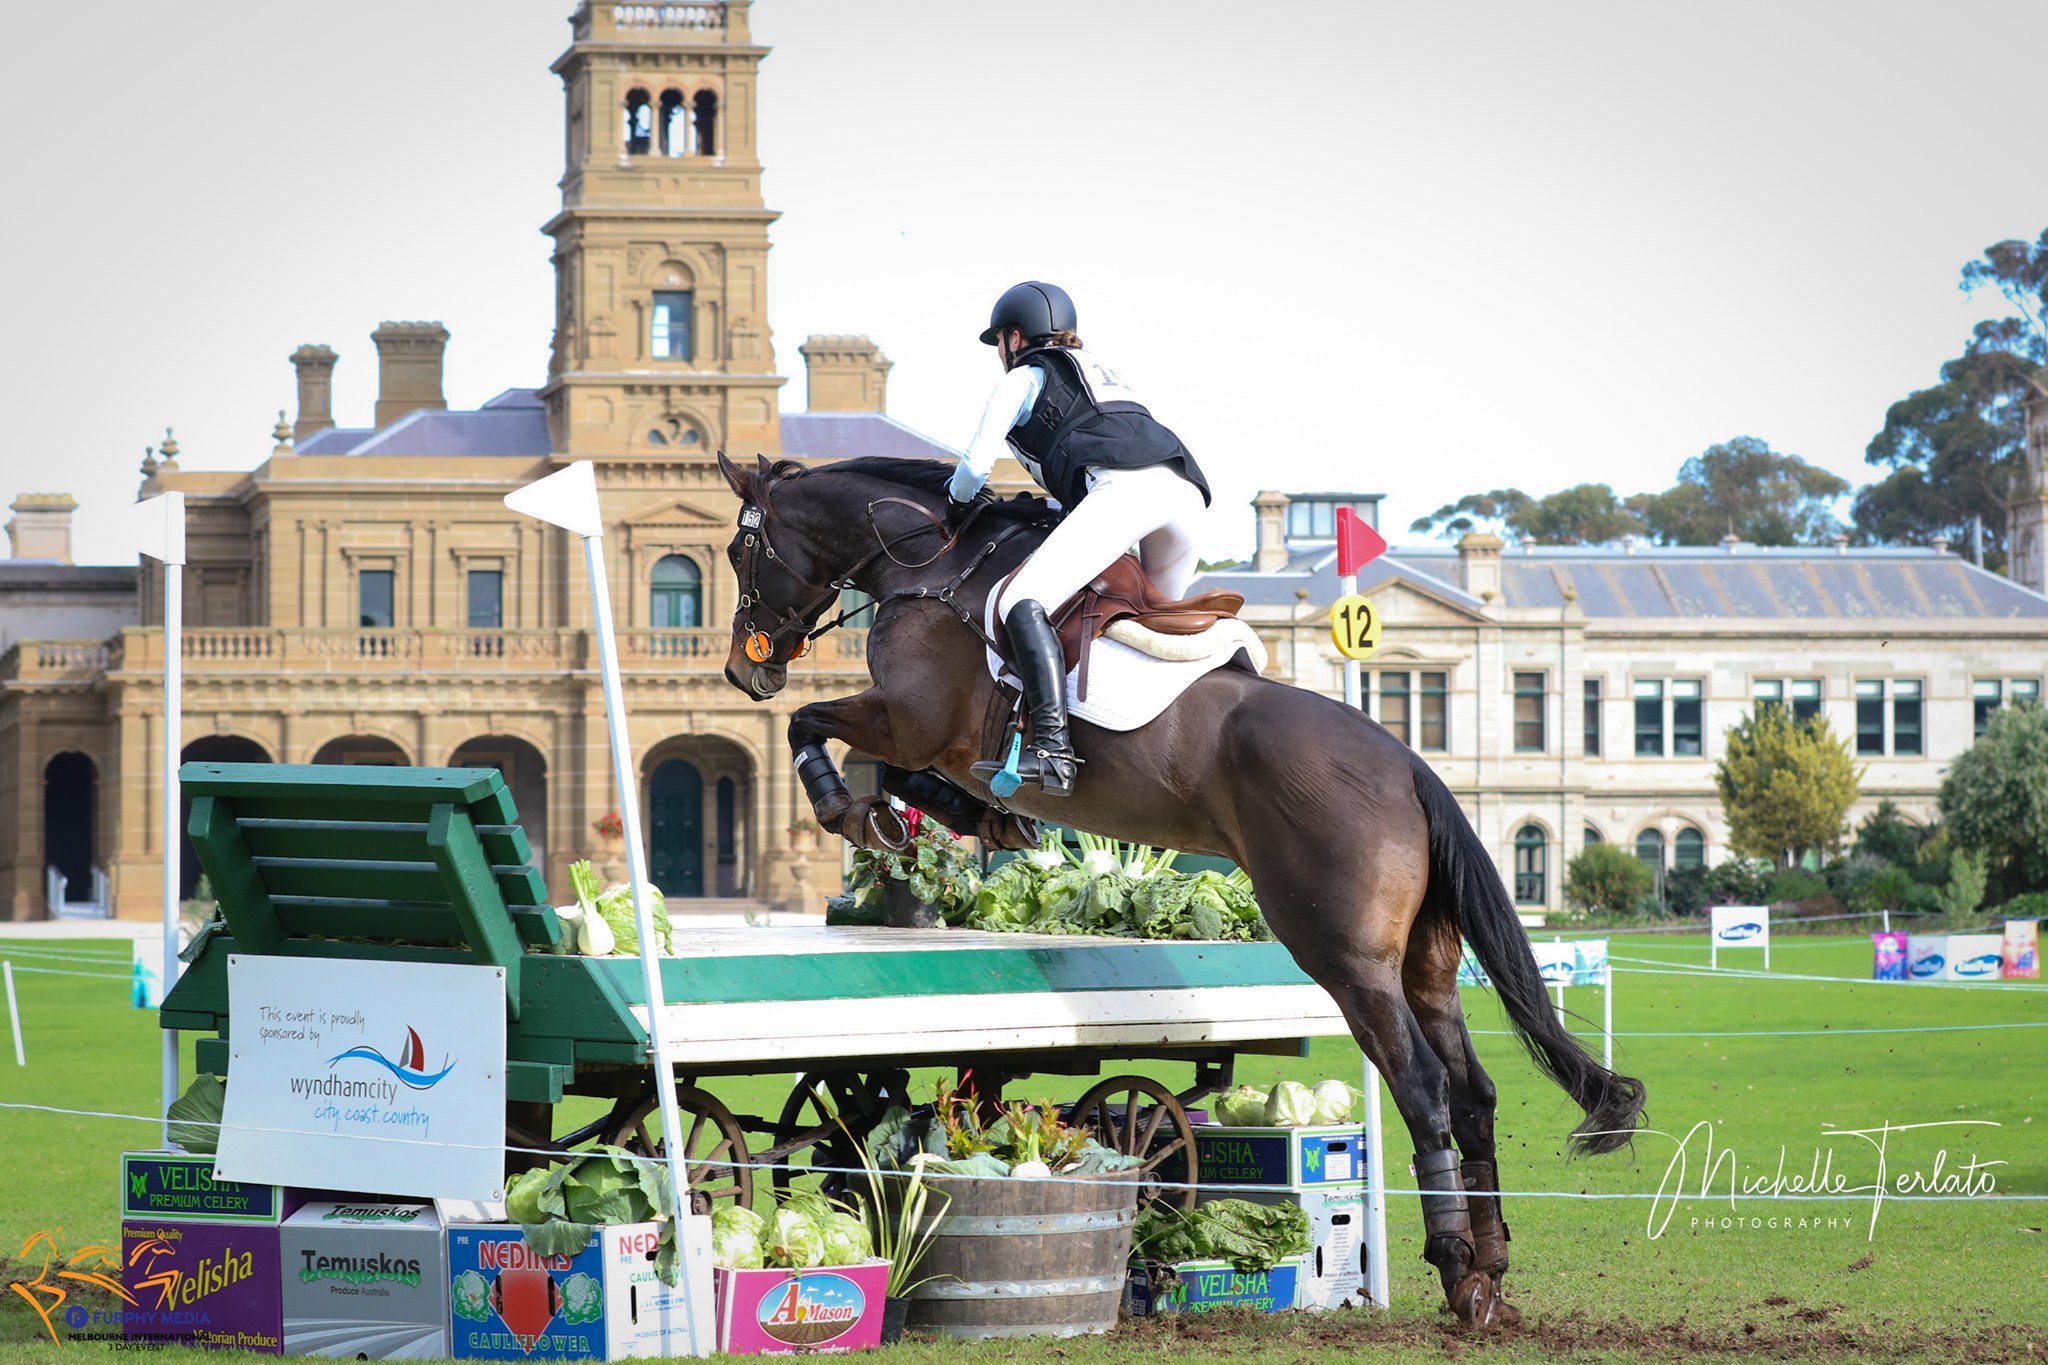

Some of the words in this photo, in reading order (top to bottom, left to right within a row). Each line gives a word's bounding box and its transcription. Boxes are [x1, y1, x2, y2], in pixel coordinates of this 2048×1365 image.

[1340, 604, 1373, 649] 12
[259, 1006, 282, 1022] This
[285, 1009, 314, 1023] event
[319, 1010, 327, 1024] is
[331, 1011, 365, 1033] proudly
[259, 1027, 305, 1046] sponsored
[309, 1028, 321, 1049] by
[1220, 1167, 1264, 1180] CELERY
[149, 1193, 200, 1208] PREMIUM
[204, 1195, 249, 1210] CELERY
[331, 1205, 421, 1218] Temuskos
[123, 1227, 155, 1239] Premium
[156, 1228, 183, 1244] Quality
[457, 1236, 470, 1245] PRE
[301, 1250, 420, 1276] Temuskos
[620, 1256, 632, 1264] PRE
[166, 1247, 253, 1312] Velisha
[1199, 1272, 1268, 1297] VELISHA
[330, 1286, 360, 1297] Produce
[361, 1287, 390, 1297] Australia
[769, 1283, 800, 1323] A
[803, 1304, 853, 1323] Mason
[193, 1329, 236, 1346] Victorian
[238, 1331, 277, 1347] Produce
[468, 1332, 591, 1353] CAULIFLOWER
